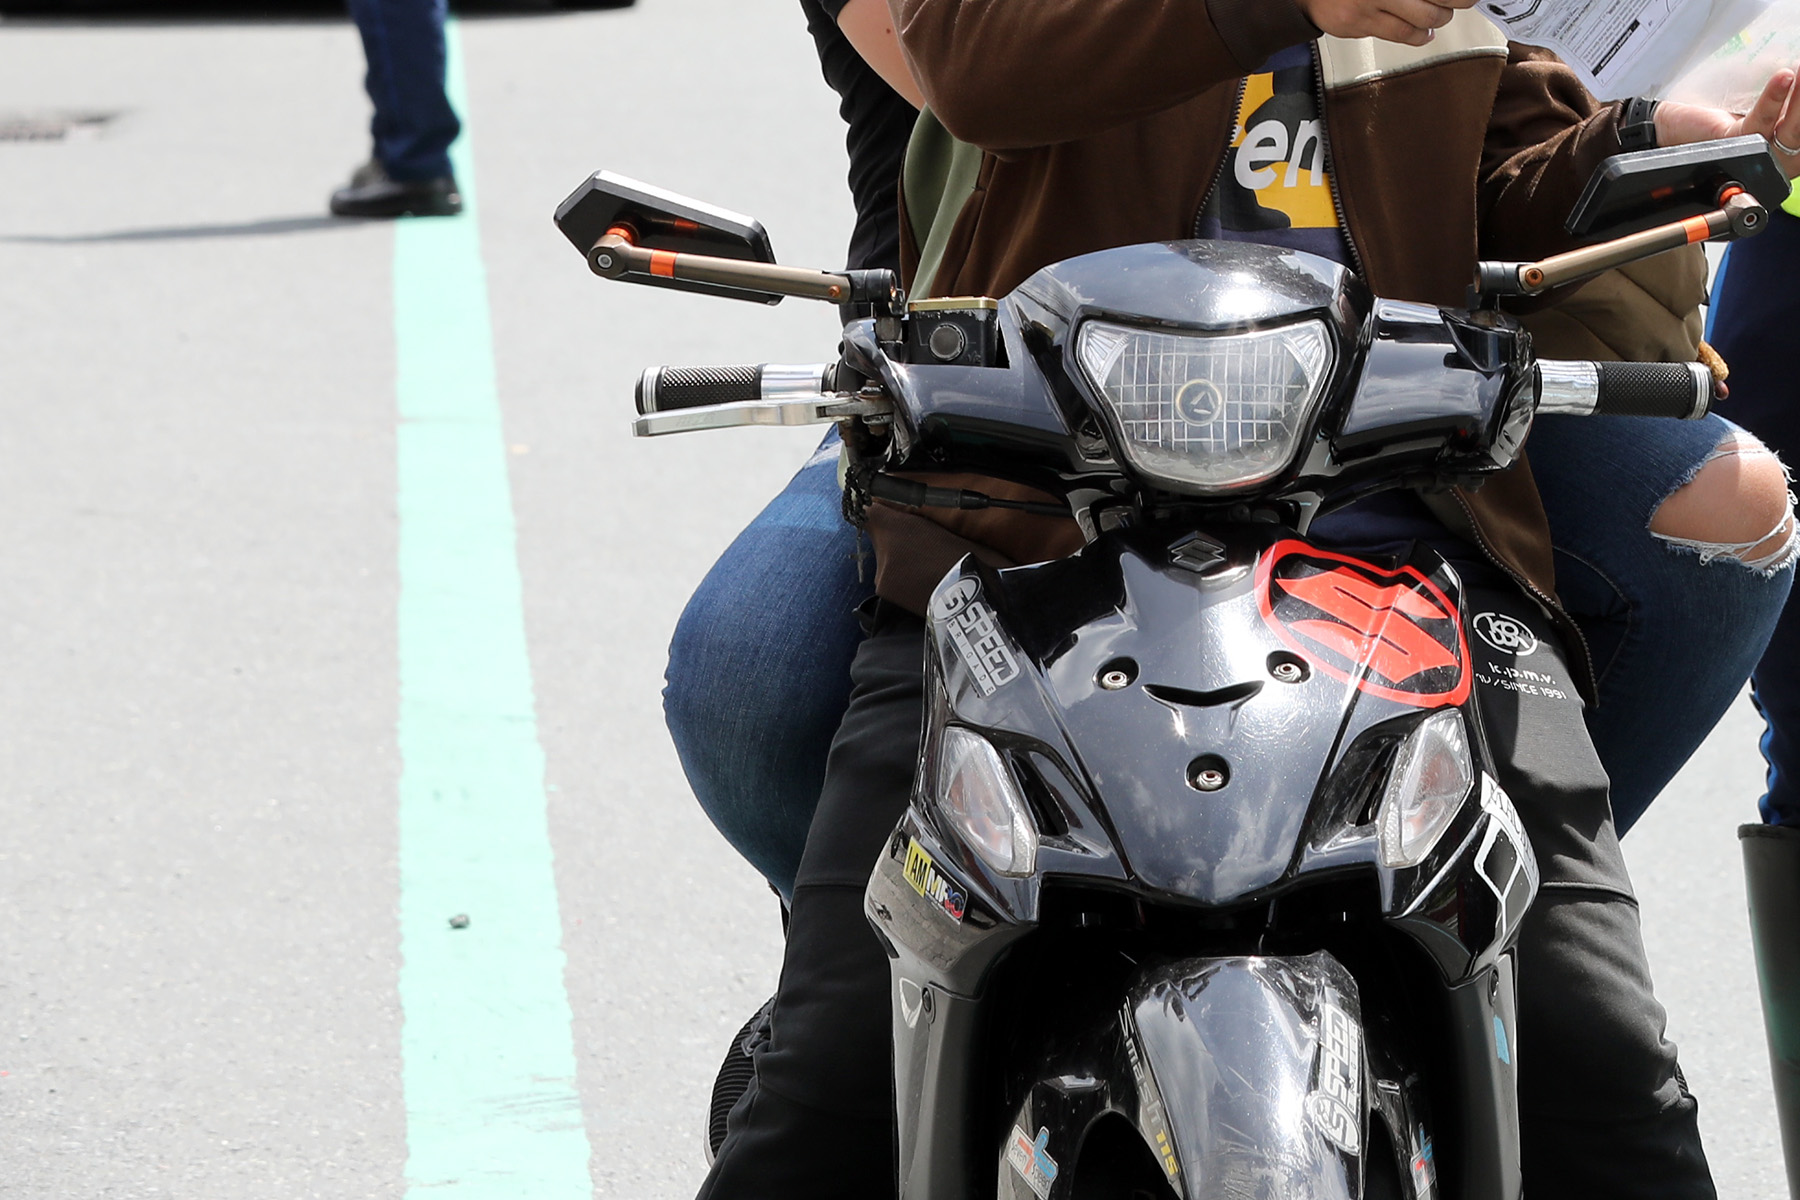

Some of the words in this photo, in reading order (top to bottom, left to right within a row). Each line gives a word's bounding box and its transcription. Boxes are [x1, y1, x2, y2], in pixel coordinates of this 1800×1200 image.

[948, 621, 996, 694] BRIGADE
[957, 601, 1020, 687] SPEED
[1488, 661, 1557, 685] k.p.m.v.
[1501, 679, 1539, 696] SINCE
[1540, 686, 1567, 700] 1991
[906, 846, 913, 873] I
[910, 852, 928, 889] AM
[1324, 1003, 1349, 1106] SPEED
[1156, 1128, 1179, 1177] 115
